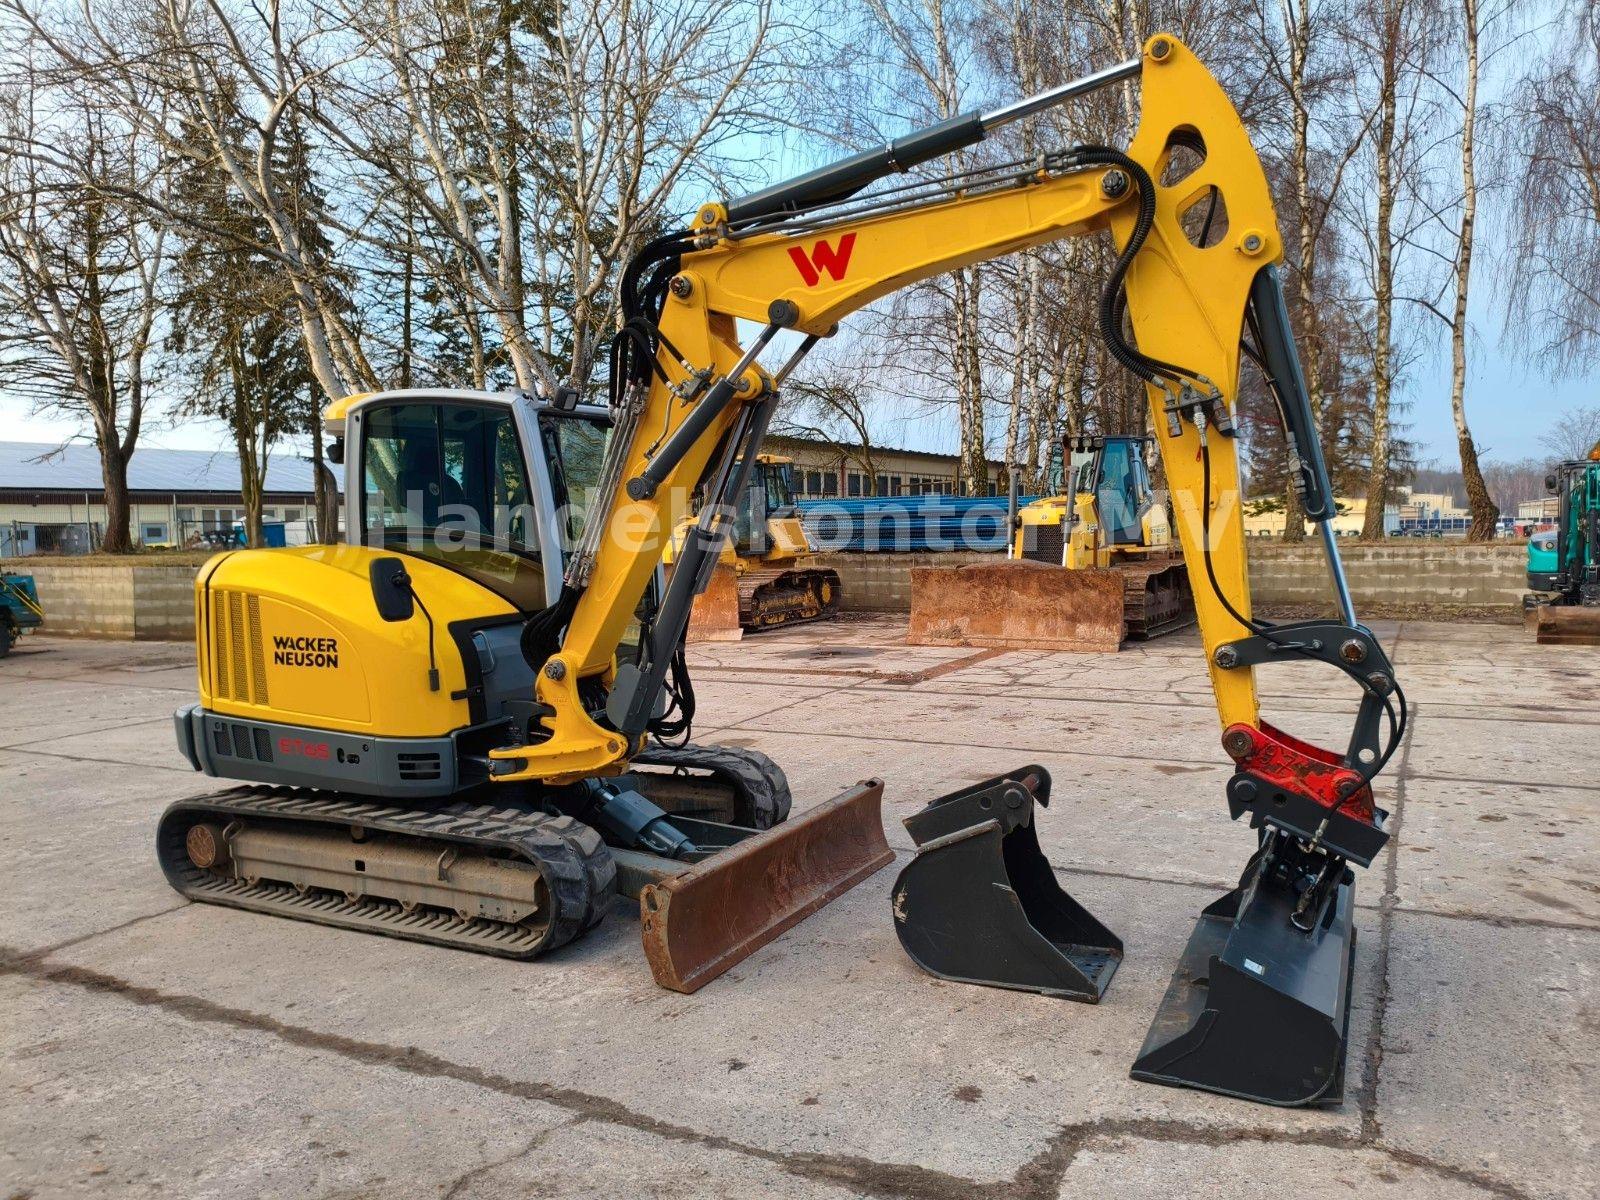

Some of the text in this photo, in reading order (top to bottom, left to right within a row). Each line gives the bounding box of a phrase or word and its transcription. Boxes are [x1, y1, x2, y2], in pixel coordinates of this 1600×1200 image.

[787, 232, 857, 287] W
[273, 636, 337, 652] WACKER
[274, 651, 338, 668] NEUSON
